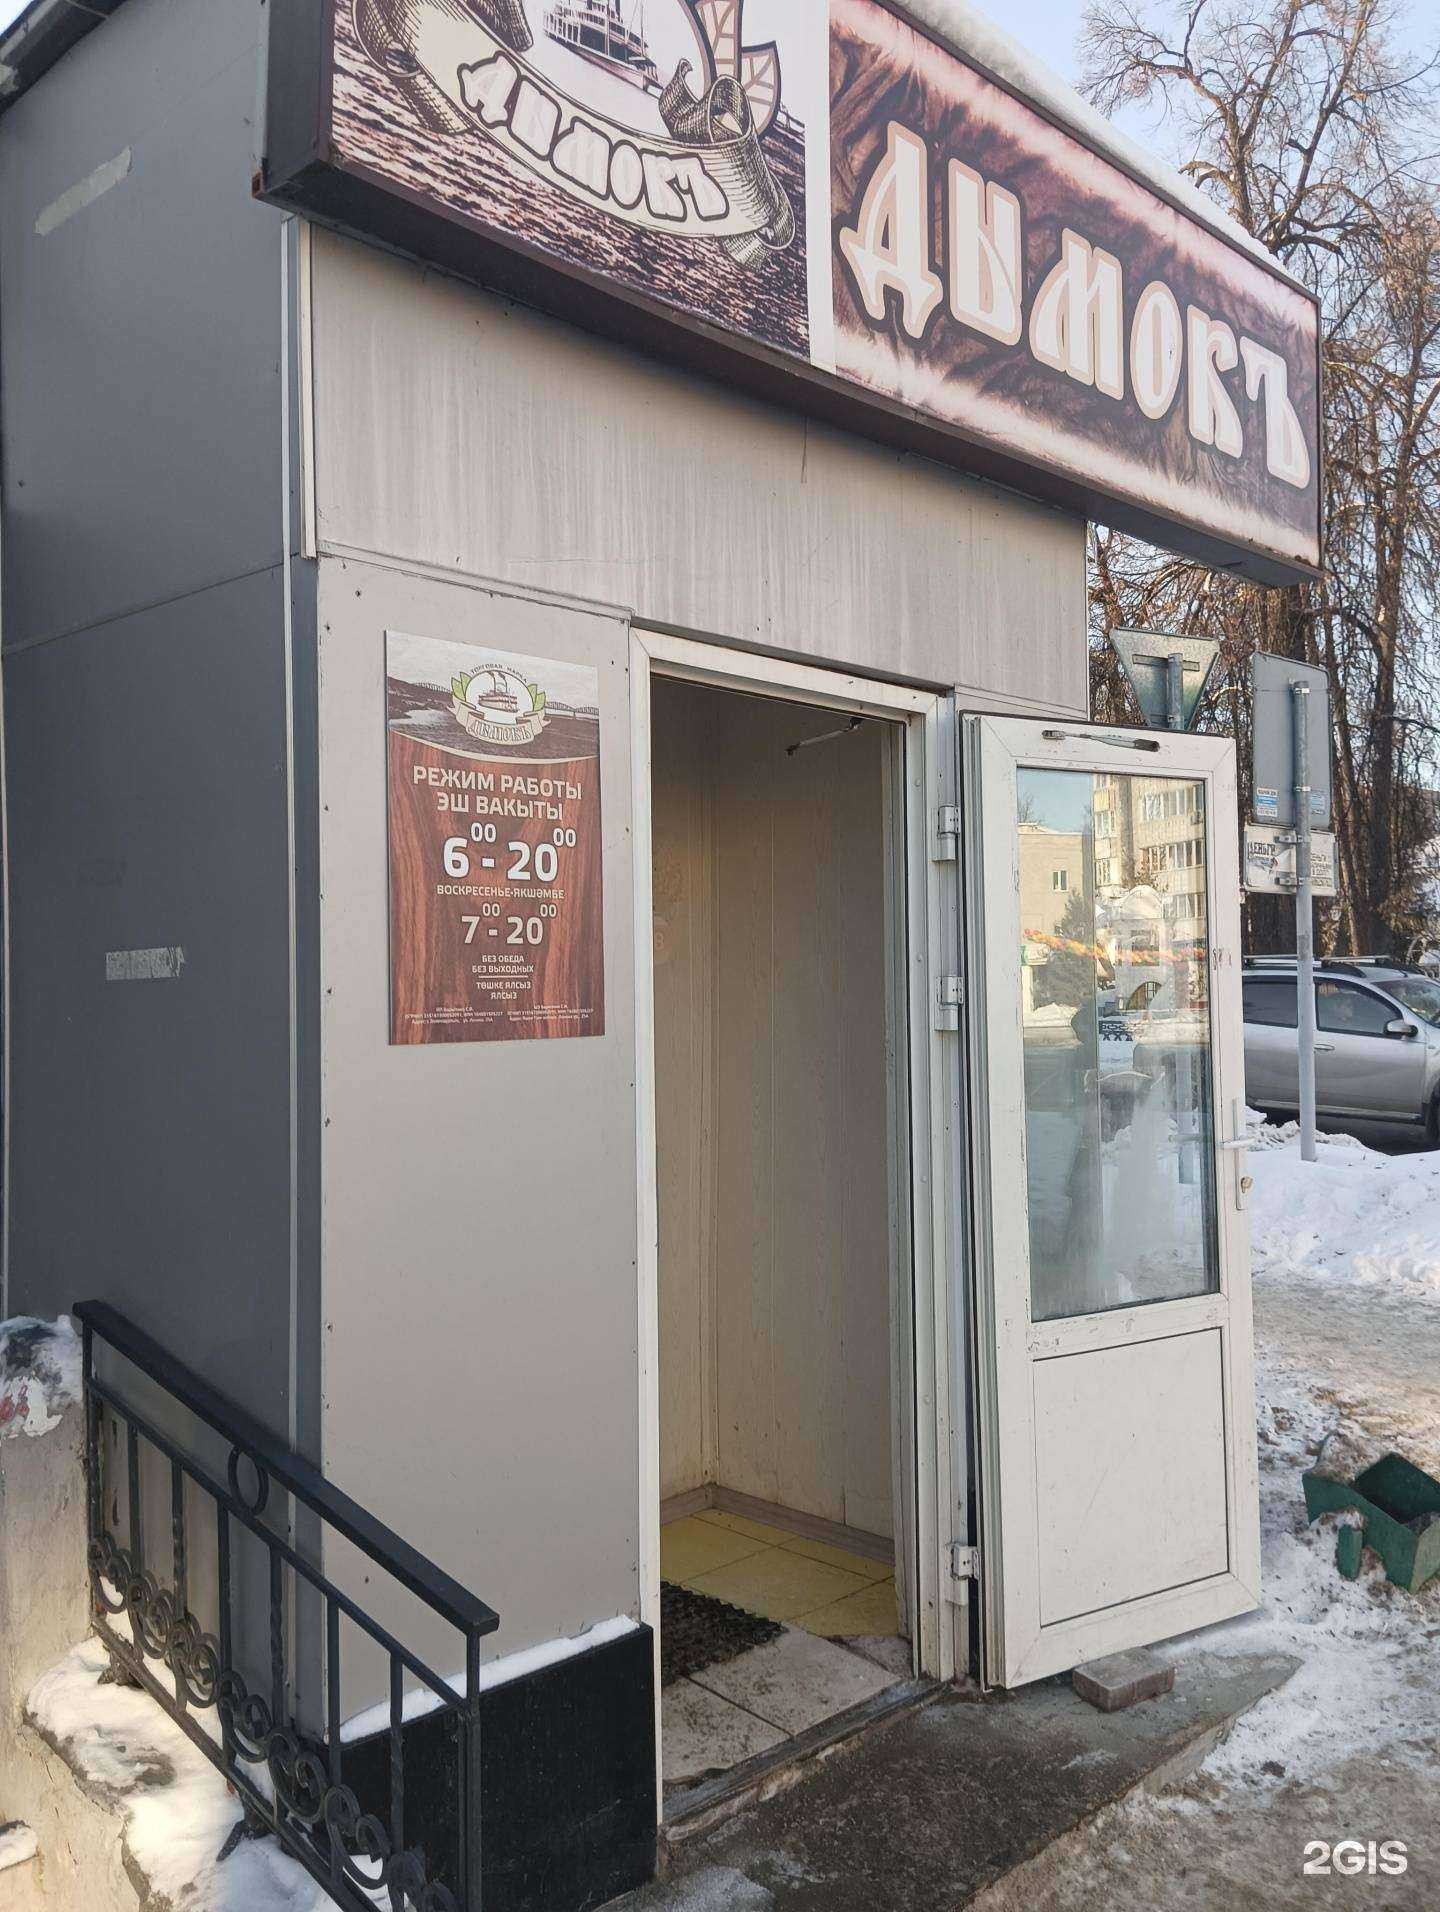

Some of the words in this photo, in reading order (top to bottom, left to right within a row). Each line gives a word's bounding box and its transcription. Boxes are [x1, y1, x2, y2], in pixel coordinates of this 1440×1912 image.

[839, 120, 1311, 490] ДЫМОКЪ
[413, 765, 494, 792] РЕЖИМ
[501, 776, 582, 800] РАБОТЫ
[437, 792, 469, 813] ЭШ
[476, 796, 563, 821] ВАКЫТЫ
[443, 837, 469, 878] 6
[507, 841, 558, 882] 20
[461, 916, 480, 944] 7
[506, 917, 543, 945] 20
[472, 965, 487, 973] БЕЗ
[488, 965, 534, 974] ВЫХОДНЫХ
[482, 954, 497, 963] БЕЗ
[498, 955, 525, 964] ОБЕДА
[490, 991, 517, 1000] ЯЛСЫЗ
[505, 981, 531, 990] ЯЛСЫЗ
